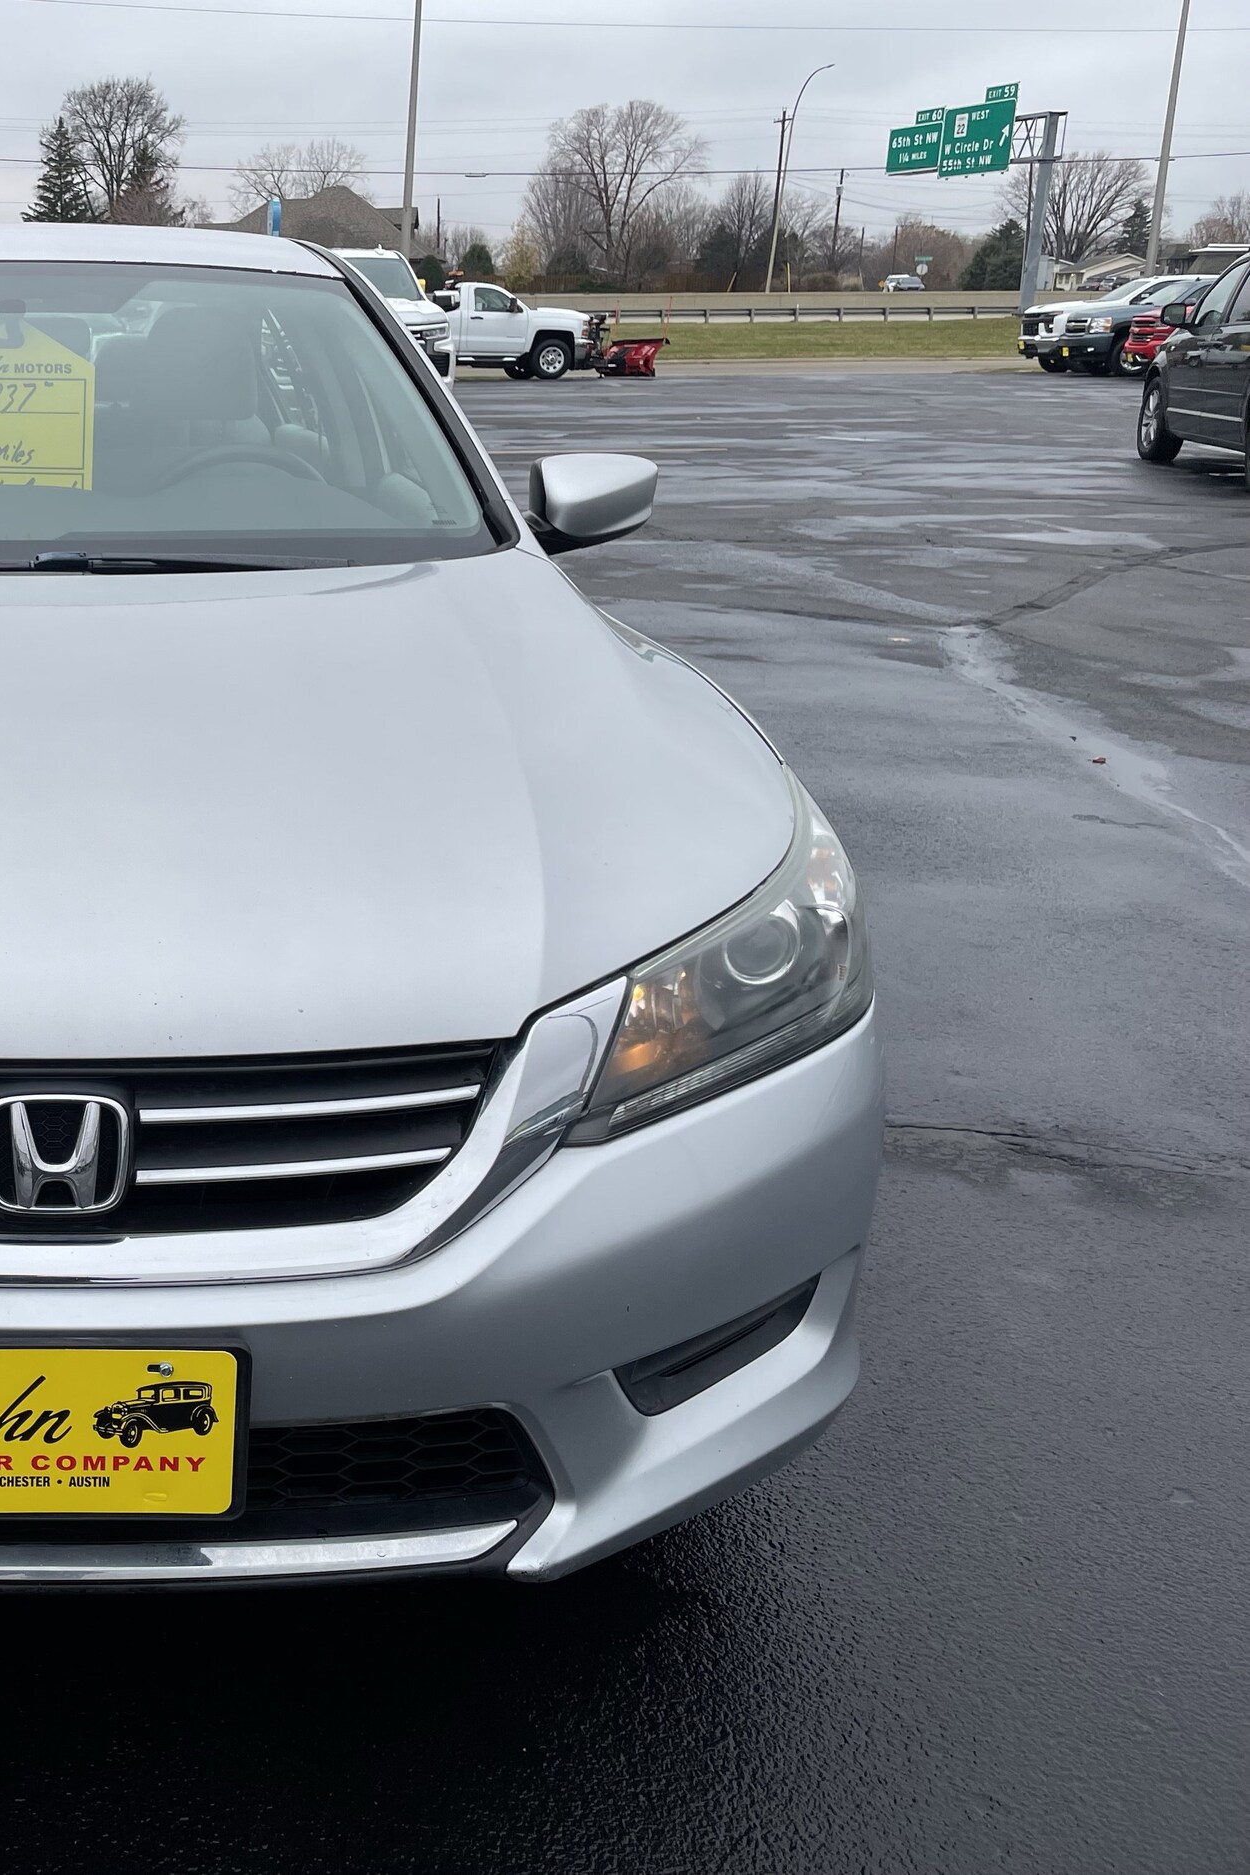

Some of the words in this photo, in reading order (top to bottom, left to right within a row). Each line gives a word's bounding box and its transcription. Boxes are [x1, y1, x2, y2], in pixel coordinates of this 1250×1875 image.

[989, 89, 1002, 99] EXIT
[1003, 85, 1016, 98] 59
[918, 113, 930, 122] EXIT
[932, 109, 943, 121] 60
[971, 110, 990, 121] WEST
[956, 123, 966, 135] 22
[892, 136, 911, 149] 65th
[913, 134, 923, 146] St
[925, 131, 939, 144] NW
[944, 144, 952, 155] W
[954, 141, 980, 154] Circle
[983, 139, 994, 151] Dr
[911, 151, 927, 160] MILES
[942, 159, 962, 171] 55th
[965, 157, 975, 169] St
[978, 155, 993, 167] NW
[14, 363, 72, 374] MOTORS
[30, 1455, 207, 1473] COMPANY
[68, 1476, 111, 1488] AUSTIN
